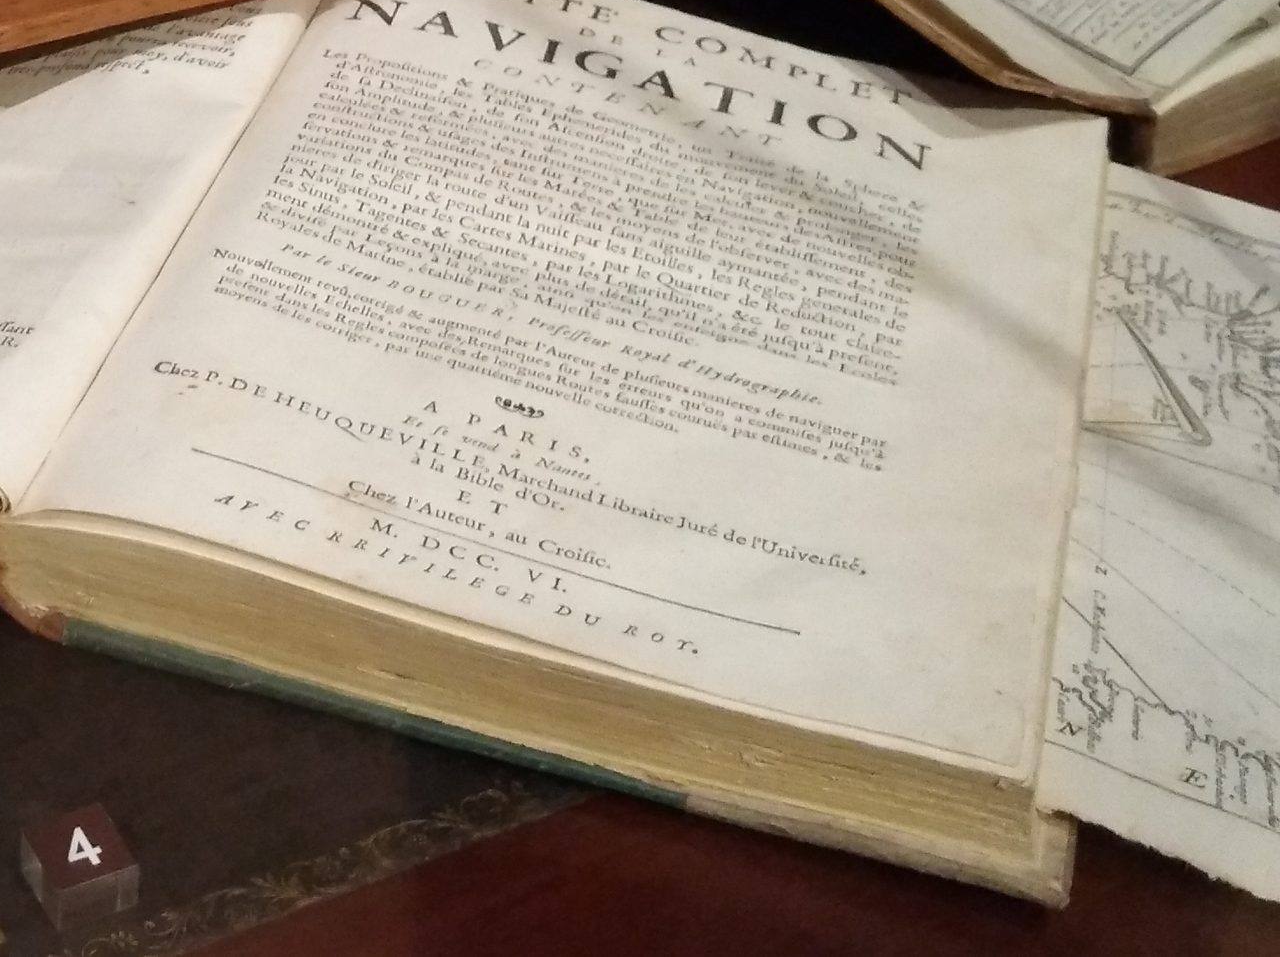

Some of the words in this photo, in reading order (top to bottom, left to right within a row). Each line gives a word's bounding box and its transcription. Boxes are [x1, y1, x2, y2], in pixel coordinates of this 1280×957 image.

[577, 26, 623, 46] DE
[654, 47, 697, 68] LA
[653, 25, 912, 106] COMPLET
[472, 57, 783, 147] CONTENANT
[443, 181, 488, 200] route
[278, 163, 294, 175] la
[400, 201, 428, 216] par
[430, 206, 454, 224] les
[457, 215, 512, 242] Cartes
[601, 259, 630, 274] par
[635, 263, 651, 280] le
[655, 271, 731, 302] Quartier
[737, 292, 760, 309] de
[874, 331, 903, 347] par
[279, 242, 312, 259] Par
[315, 253, 333, 267] le
[319, 162, 345, 176] par
[349, 166, 365, 180] le
[423, 190, 442, 204] &
[443, 197, 513, 224] pendant
[516, 213, 531, 230] la
[534, 222, 570, 239] nuit
[571, 233, 599, 248] par
[604, 237, 627, 256] les
[710, 267, 732, 285] les
[736, 274, 796, 302] Regles
[884, 317, 907, 333] de
[355, 200, 427, 232] Tagentes
[430, 225, 449, 239] &
[544, 259, 573, 273] par
[577, 264, 600, 282] les
[152, 360, 200, 379] Chez
[203, 369, 223, 386] P.
[496, 462, 594, 503] Marchand
[595, 492, 675, 525] Libraire
[675, 515, 719, 538] Juré
[722, 527, 748, 546] de
[422, 399, 438, 415] A
[466, 411, 591, 464] PARIS,
[347, 479, 397, 504] Chez
[504, 531, 528, 546] au
[410, 455, 421, 466] à
[428, 457, 445, 474] la
[455, 465, 505, 492] Bible
[514, 485, 565, 512] d'Or.
[212, 494, 312, 532] AVEC
[553, 603, 602, 627] DU
[368, 517, 398, 539] M.
[67, 826, 102, 866] 4
